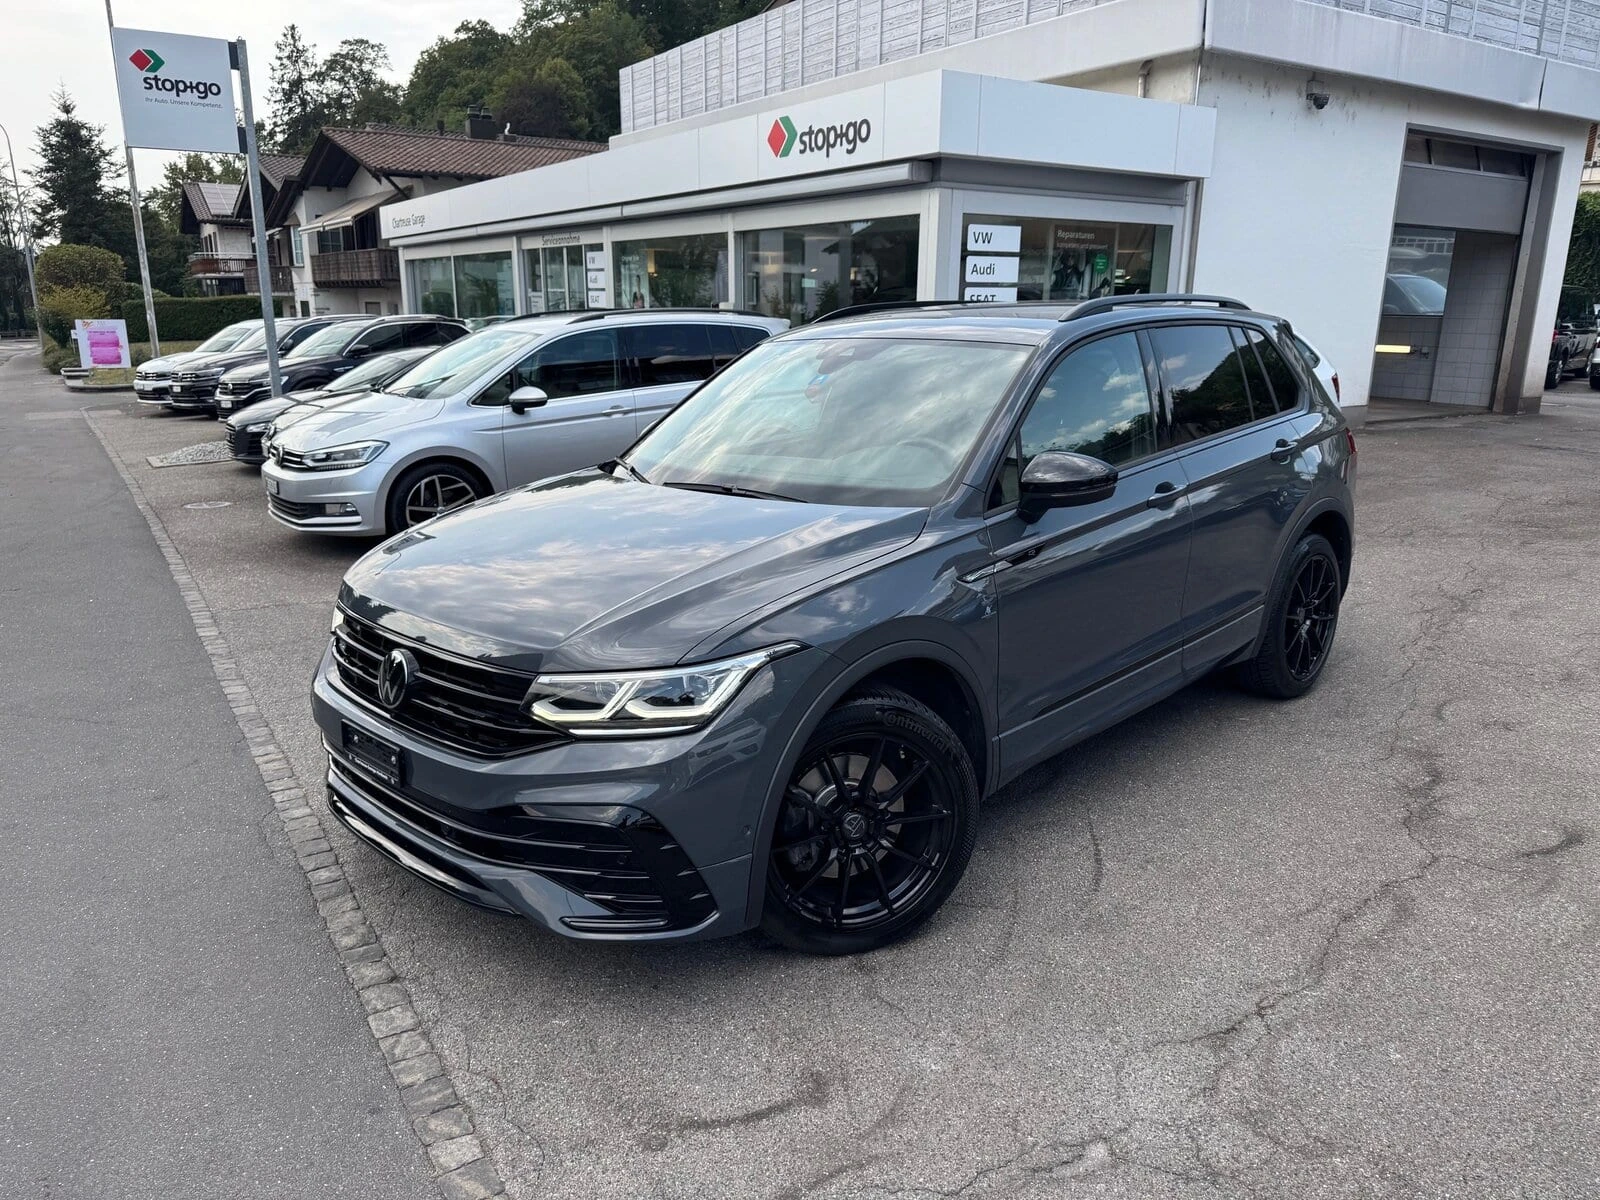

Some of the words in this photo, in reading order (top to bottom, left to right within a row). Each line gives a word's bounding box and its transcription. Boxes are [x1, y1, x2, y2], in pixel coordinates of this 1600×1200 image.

[143, 75, 221, 100] stop+go
[190, 100, 223, 109] Kompetenz.
[799, 118, 871, 158] stop+go
[392, 217, 411, 229] Chartreuse
[412, 213, 426, 227] Garage
[973, 231, 993, 244] VW
[1057, 229, 1095, 240] Reparaturen
[589, 256, 596, 265] VW
[971, 263, 996, 275] Audi
[590, 295, 600, 304] SEAT
